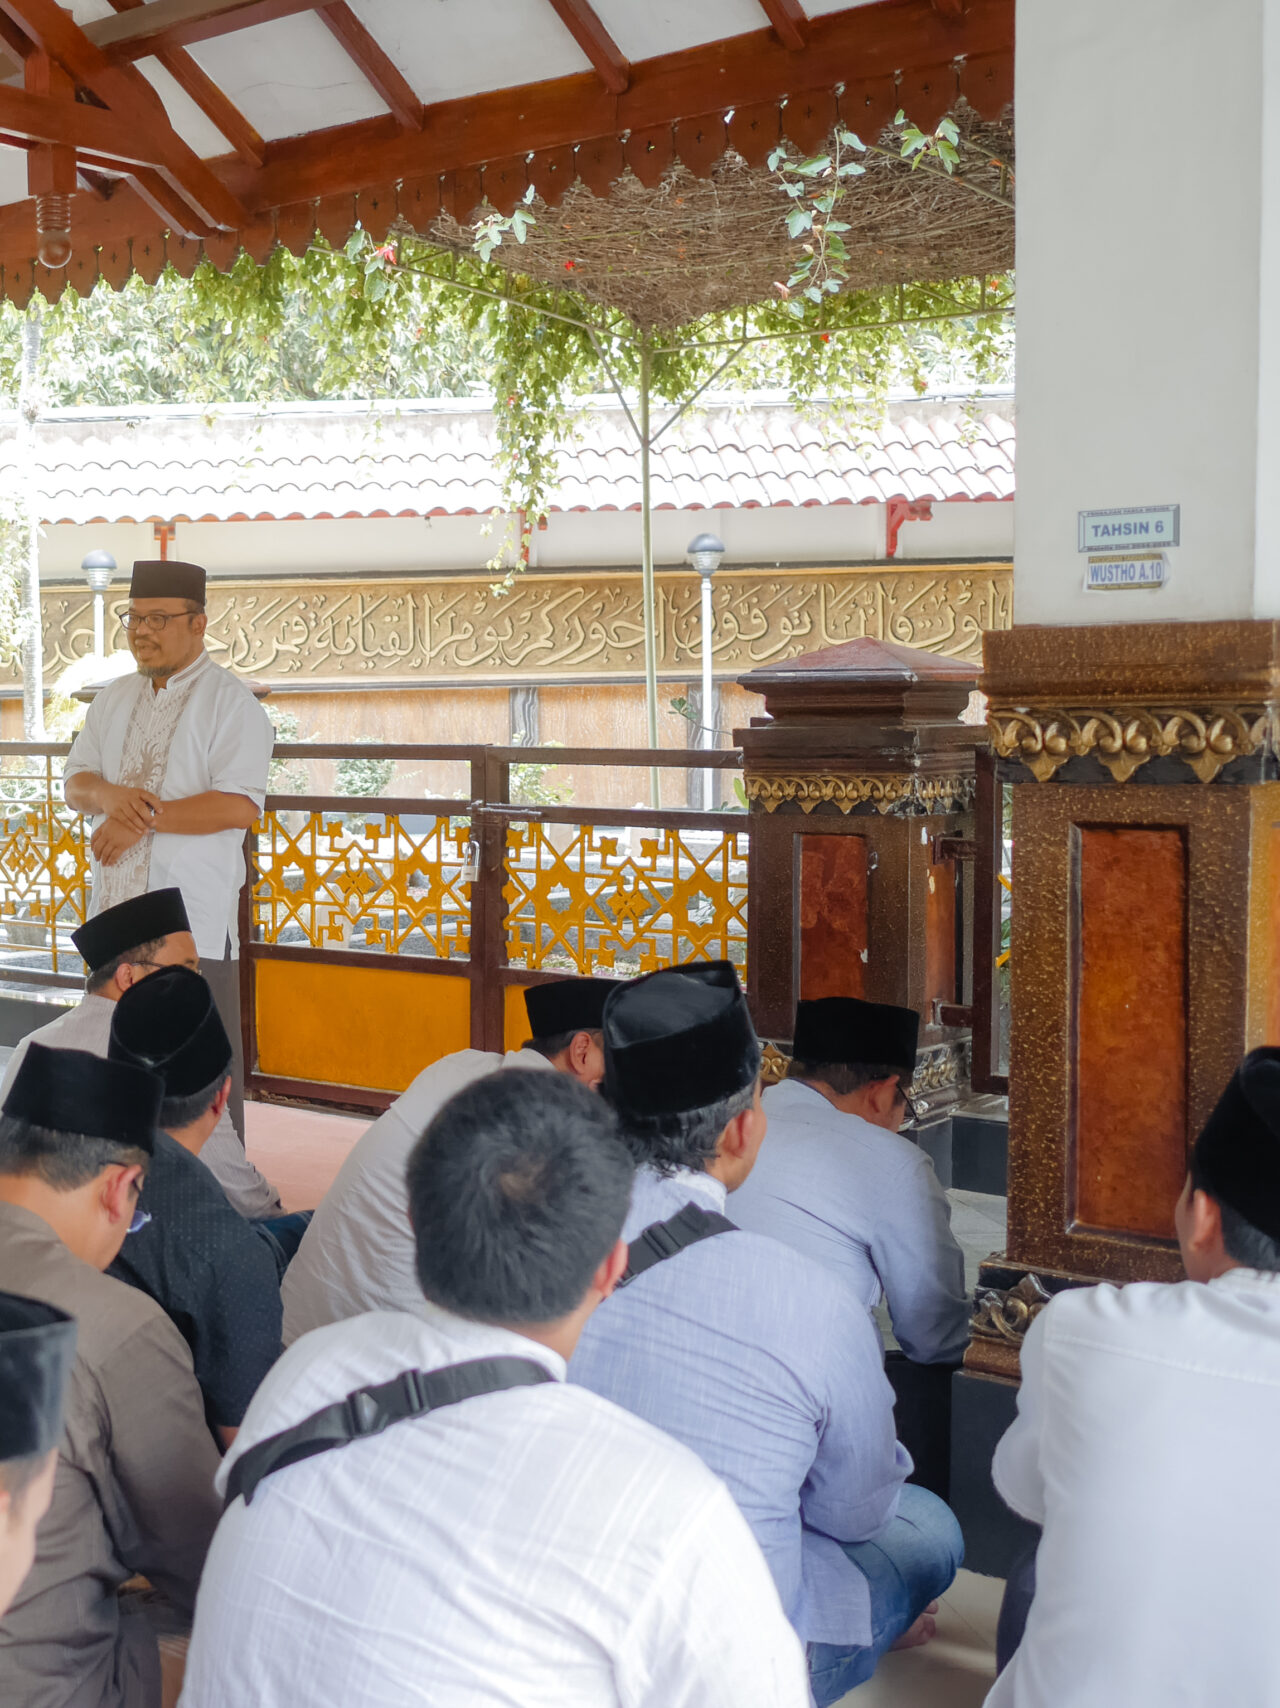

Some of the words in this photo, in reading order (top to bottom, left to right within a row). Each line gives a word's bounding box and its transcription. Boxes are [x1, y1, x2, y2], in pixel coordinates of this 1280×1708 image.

[1091, 521, 1150, 537] TAHSIN
[1154, 520, 1164, 534] 6
[1090, 563, 1136, 583] WUSTHO
[1138, 561, 1161, 580] A.10
